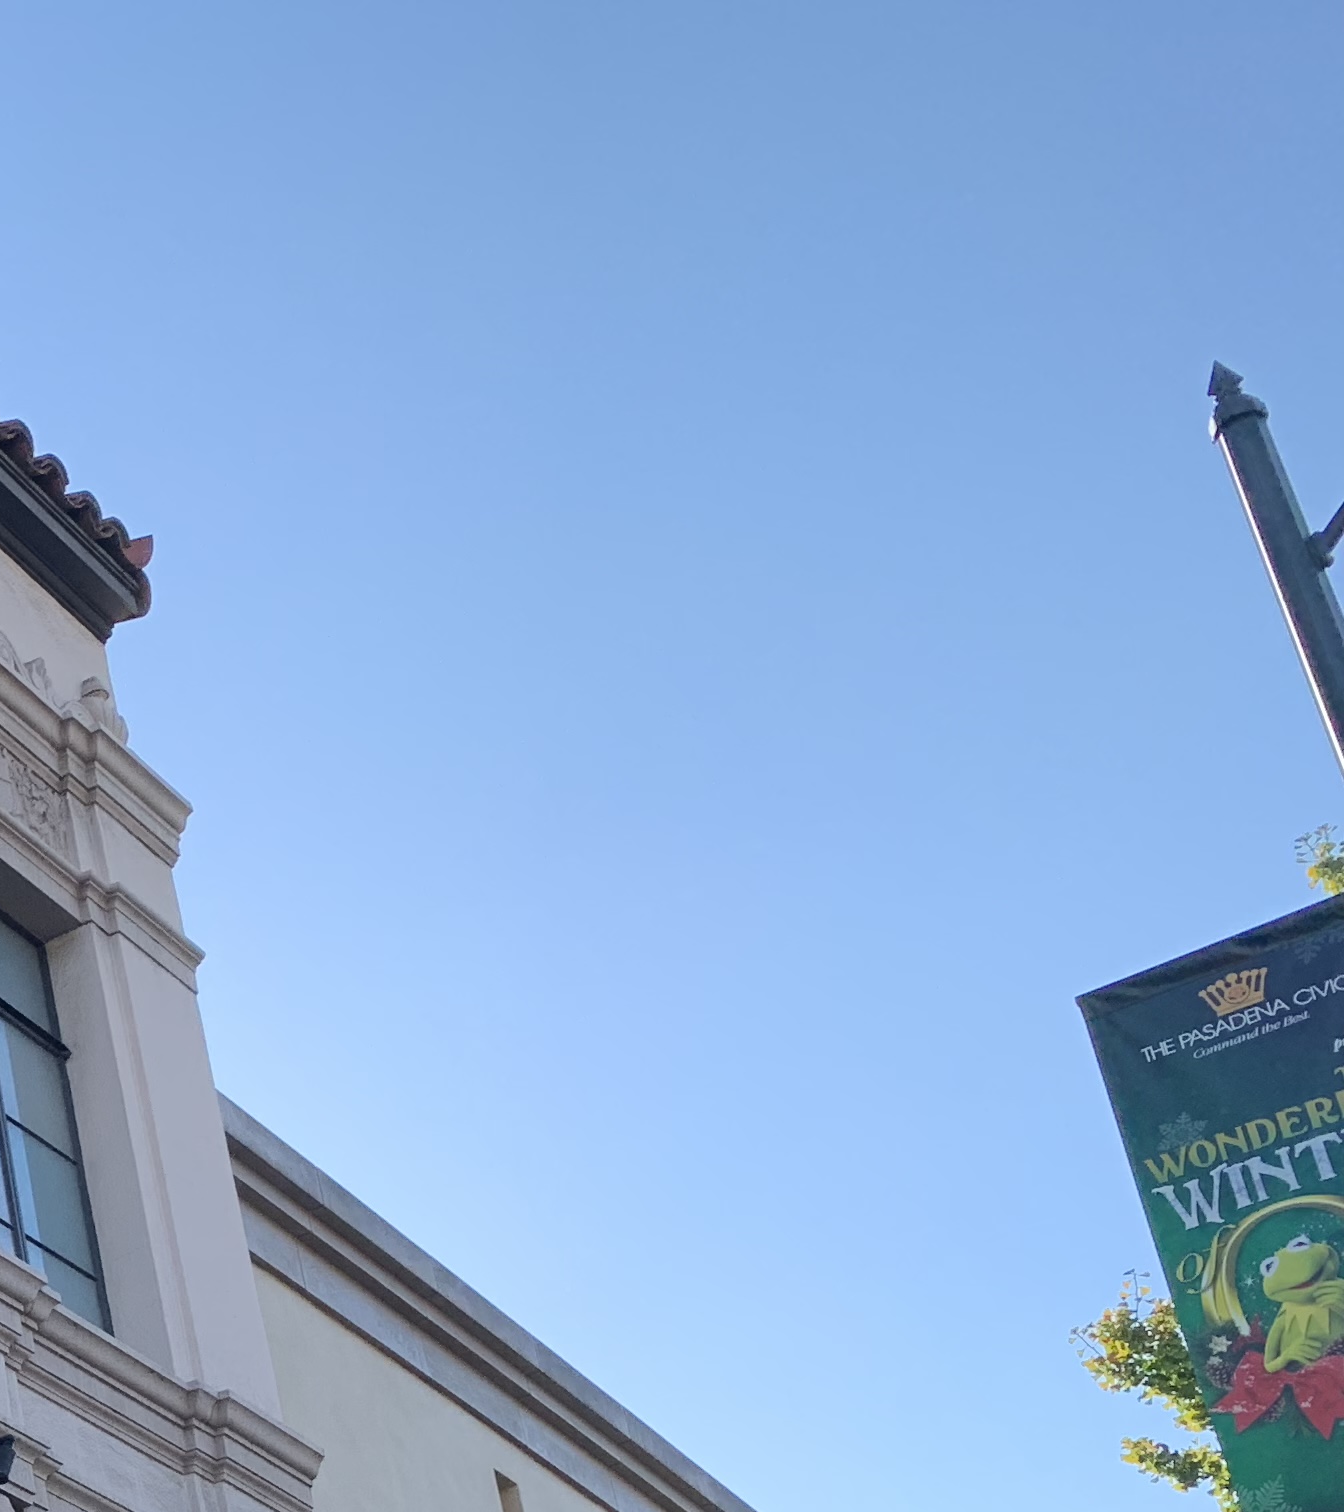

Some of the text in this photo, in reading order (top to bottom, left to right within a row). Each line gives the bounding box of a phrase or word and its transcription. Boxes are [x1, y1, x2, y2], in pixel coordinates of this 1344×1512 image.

[1140, 1038, 1177, 1063] THE
[1178, 998, 1291, 1050] PASADENA
[1192, 1027, 1260, 1060] Command
[1261, 1019, 1282, 1036] the
[1151, 1129, 1344, 1231] WINT
